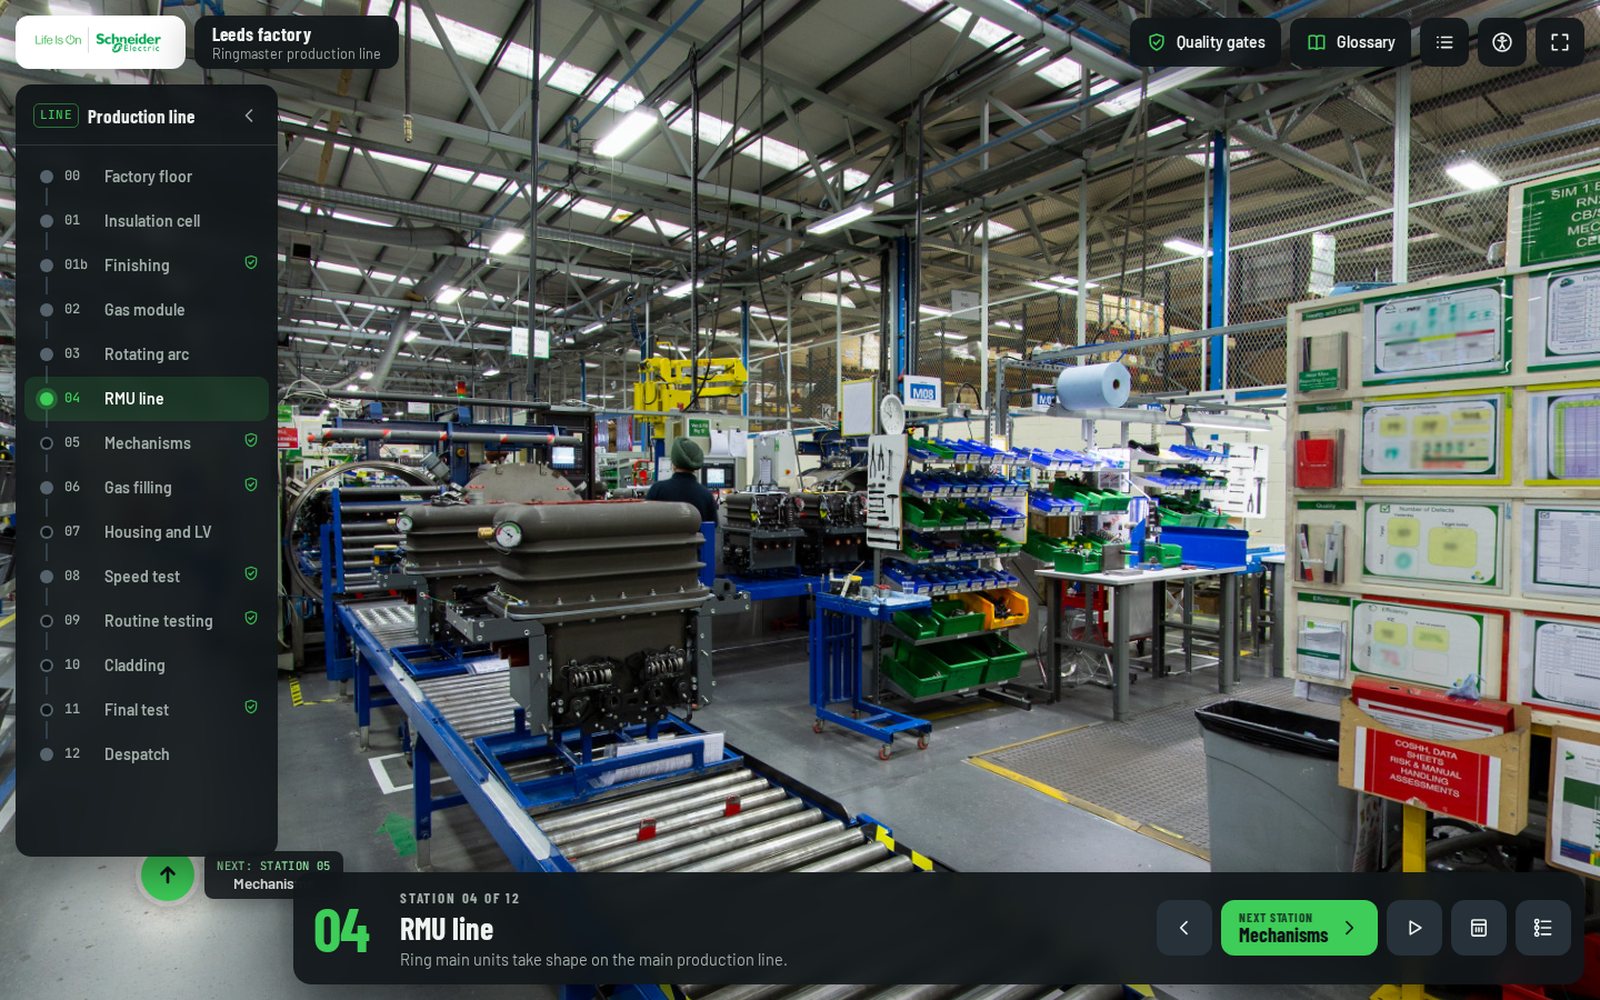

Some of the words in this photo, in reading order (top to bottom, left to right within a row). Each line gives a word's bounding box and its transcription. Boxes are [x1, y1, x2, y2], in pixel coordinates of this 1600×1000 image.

[1551, 186, 1577, 200] SIM
[1576, 195, 1600, 208] RN
[1576, 235, 1600, 247] CE
[912, 387, 934, 400] M08
[1406, 750, 1445, 766] SHEETS
[1432, 747, 1458, 760] DATA
[1390, 755, 1412, 767] RISK
[1412, 761, 1420, 769] &
[1421, 763, 1462, 780] MANUAL
[1400, 767, 1449, 786] HANDLING
[1389, 773, 1460, 798] ASSESSMENTS
